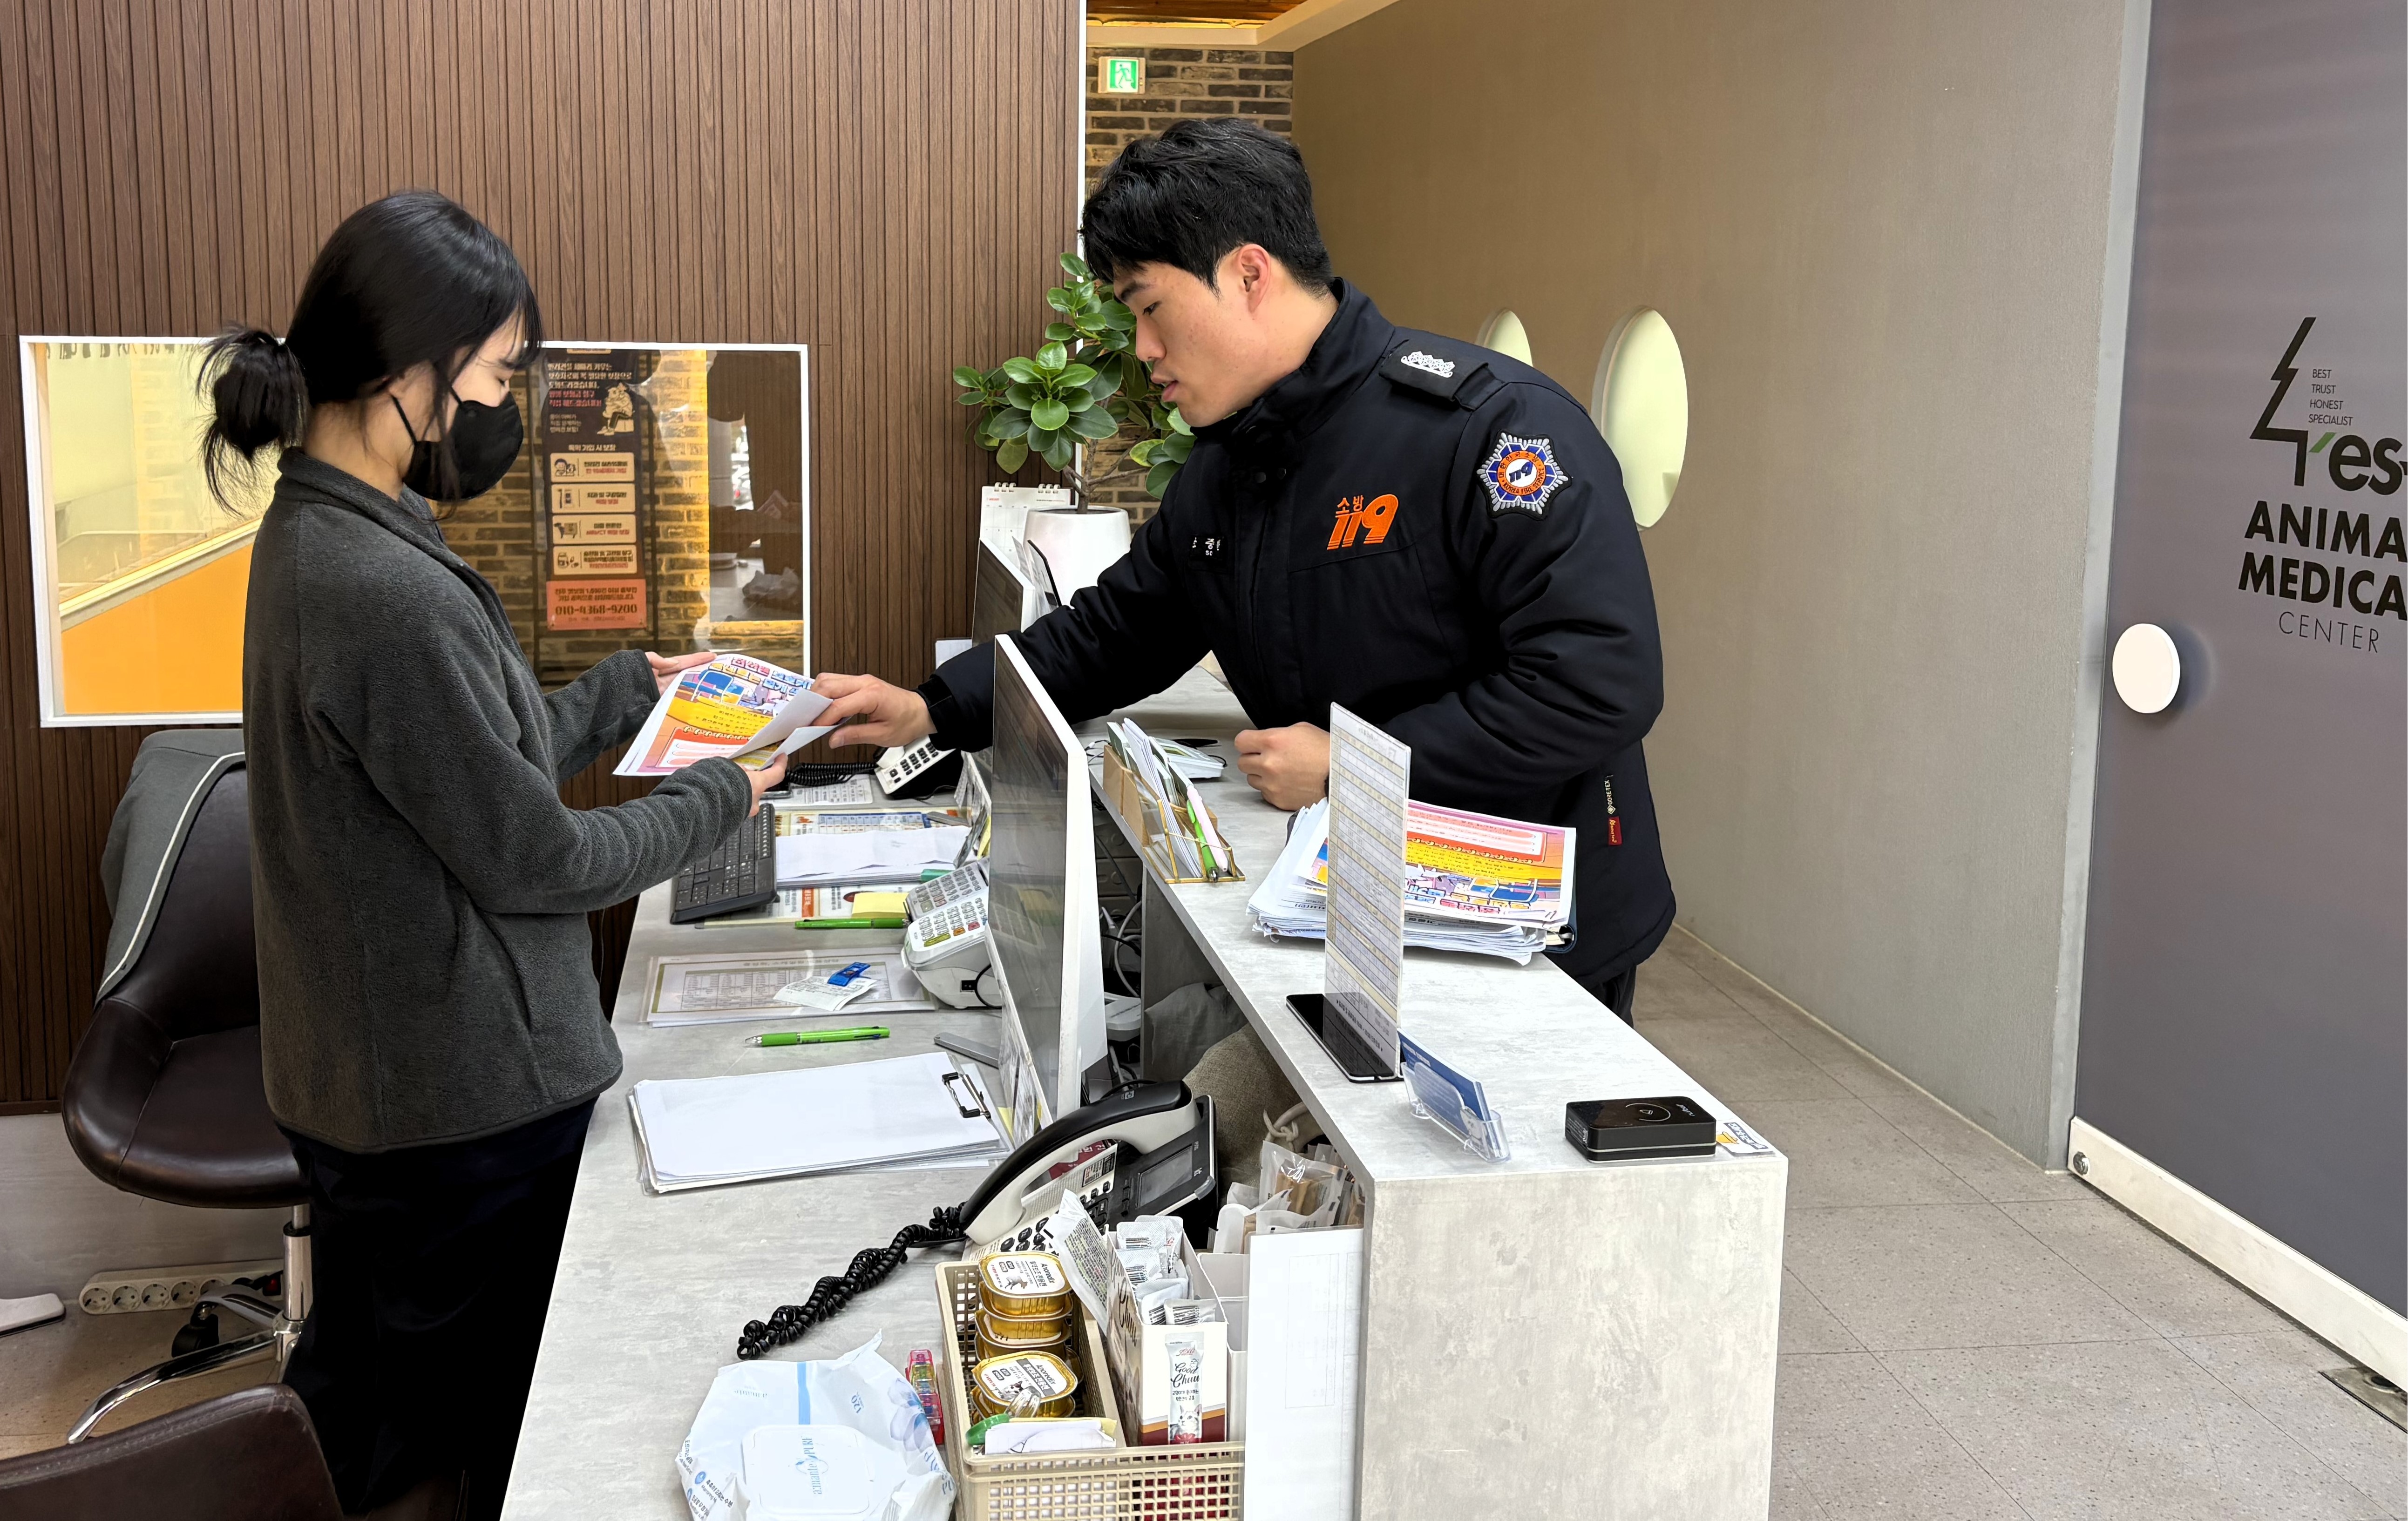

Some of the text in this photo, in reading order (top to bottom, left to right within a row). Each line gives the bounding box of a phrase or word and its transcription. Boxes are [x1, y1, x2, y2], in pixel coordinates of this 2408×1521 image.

[2312, 369, 2332, 379] BEST
[2311, 384, 2336, 395] TRUST
[2310, 399, 2344, 410] HONEST
[2308, 414, 2353, 426] SPECIALIST
[1503, 482, 1519, 494] KOREA
[1533, 467, 1545, 488] SERVICE
[1509, 461, 1533, 483] 119
[1336, 495, 1364, 514] 소방
[1327, 494, 1398, 550] 119
[2279, 611, 2379, 653] CENTER
[1175, 1362, 1199, 1374] Good
[851, 1395, 861, 1413] 120
